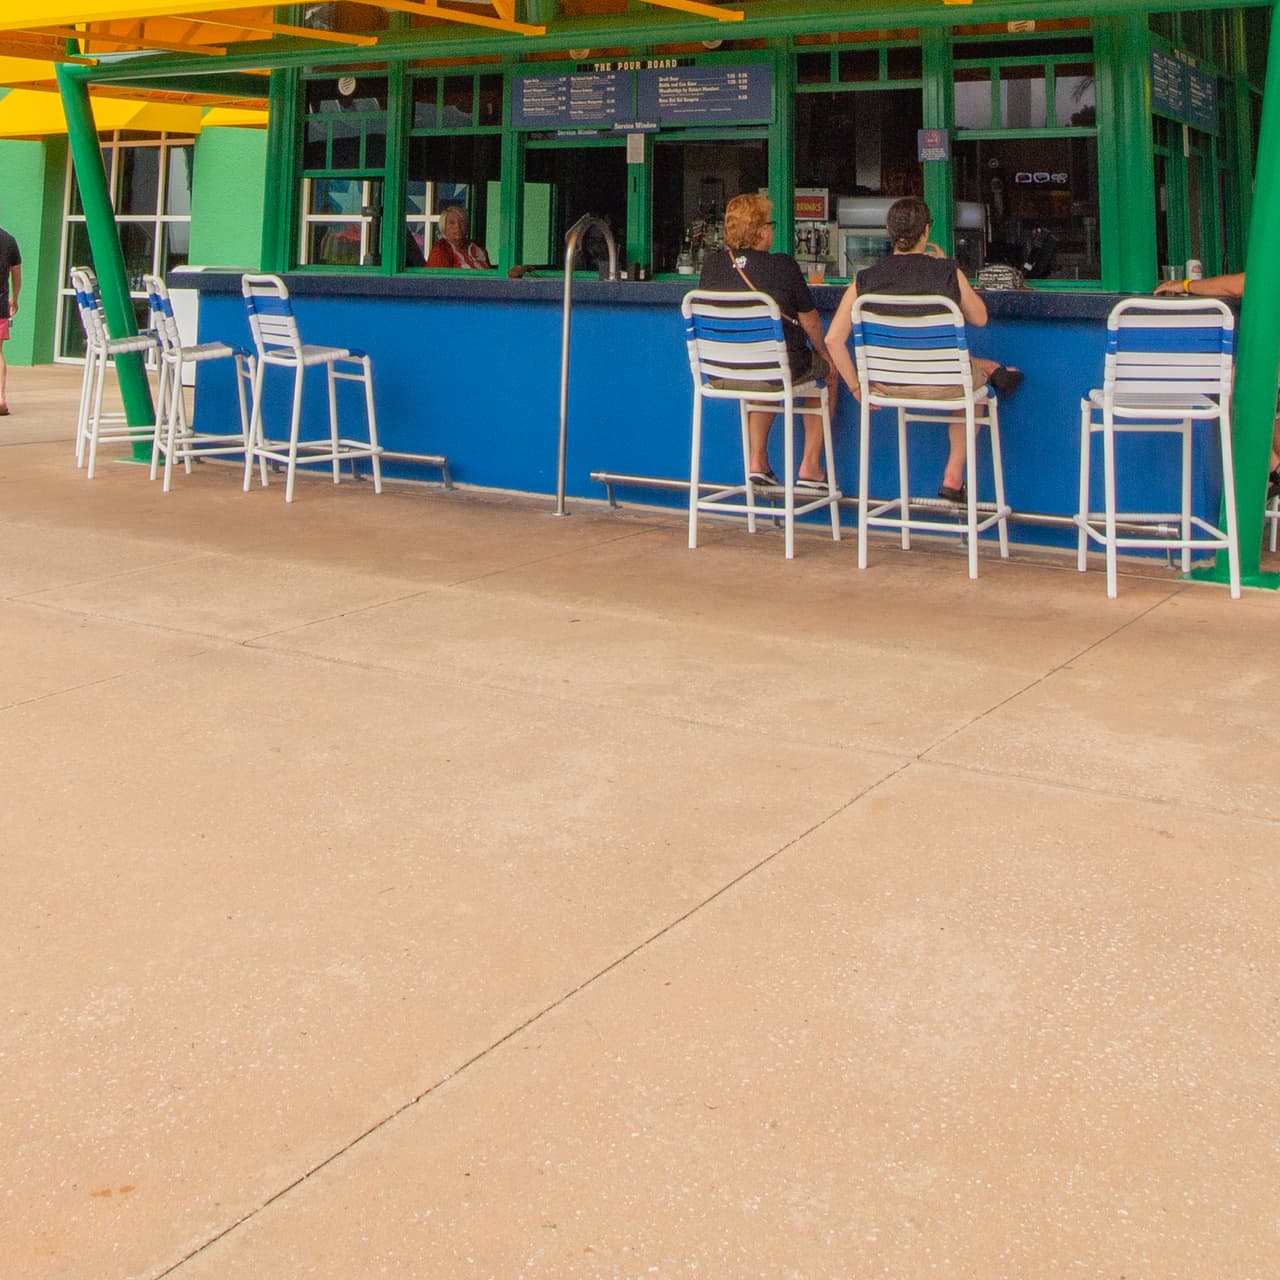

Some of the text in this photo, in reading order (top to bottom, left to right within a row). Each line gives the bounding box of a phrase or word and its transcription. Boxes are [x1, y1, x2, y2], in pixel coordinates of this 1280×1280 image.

[594, 59, 677, 72] THE POUR BOARD
